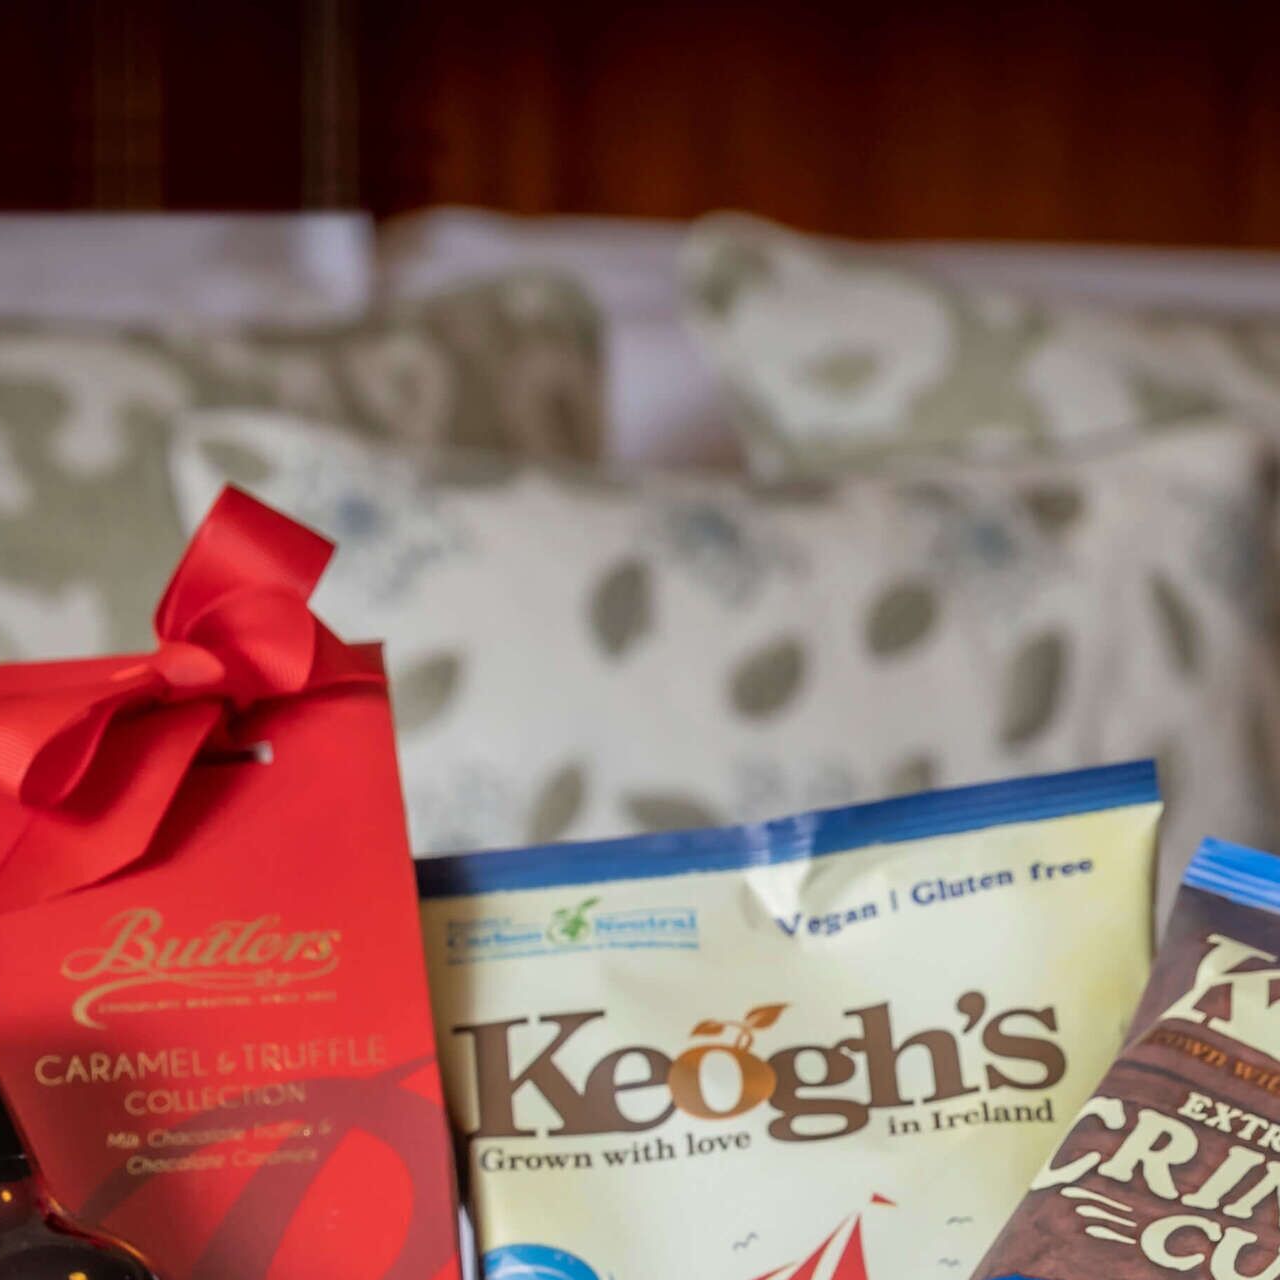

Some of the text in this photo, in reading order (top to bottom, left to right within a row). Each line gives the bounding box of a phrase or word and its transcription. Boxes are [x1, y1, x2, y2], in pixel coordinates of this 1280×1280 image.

[775, 858, 1093, 938] Vegan Gluten free
[60, 907, 342, 981] Butlers
[35, 1035, 386, 1085] CARAMEL & TRUFFLE
[452, 990, 1067, 1143] Keogh's
[123, 1081, 306, 1116] COLLECTION
[888, 1098, 1056, 1135] in Ireland
[126, 1154, 226, 1175] Chocolate
[479, 1128, 750, 1173] Grown with love
